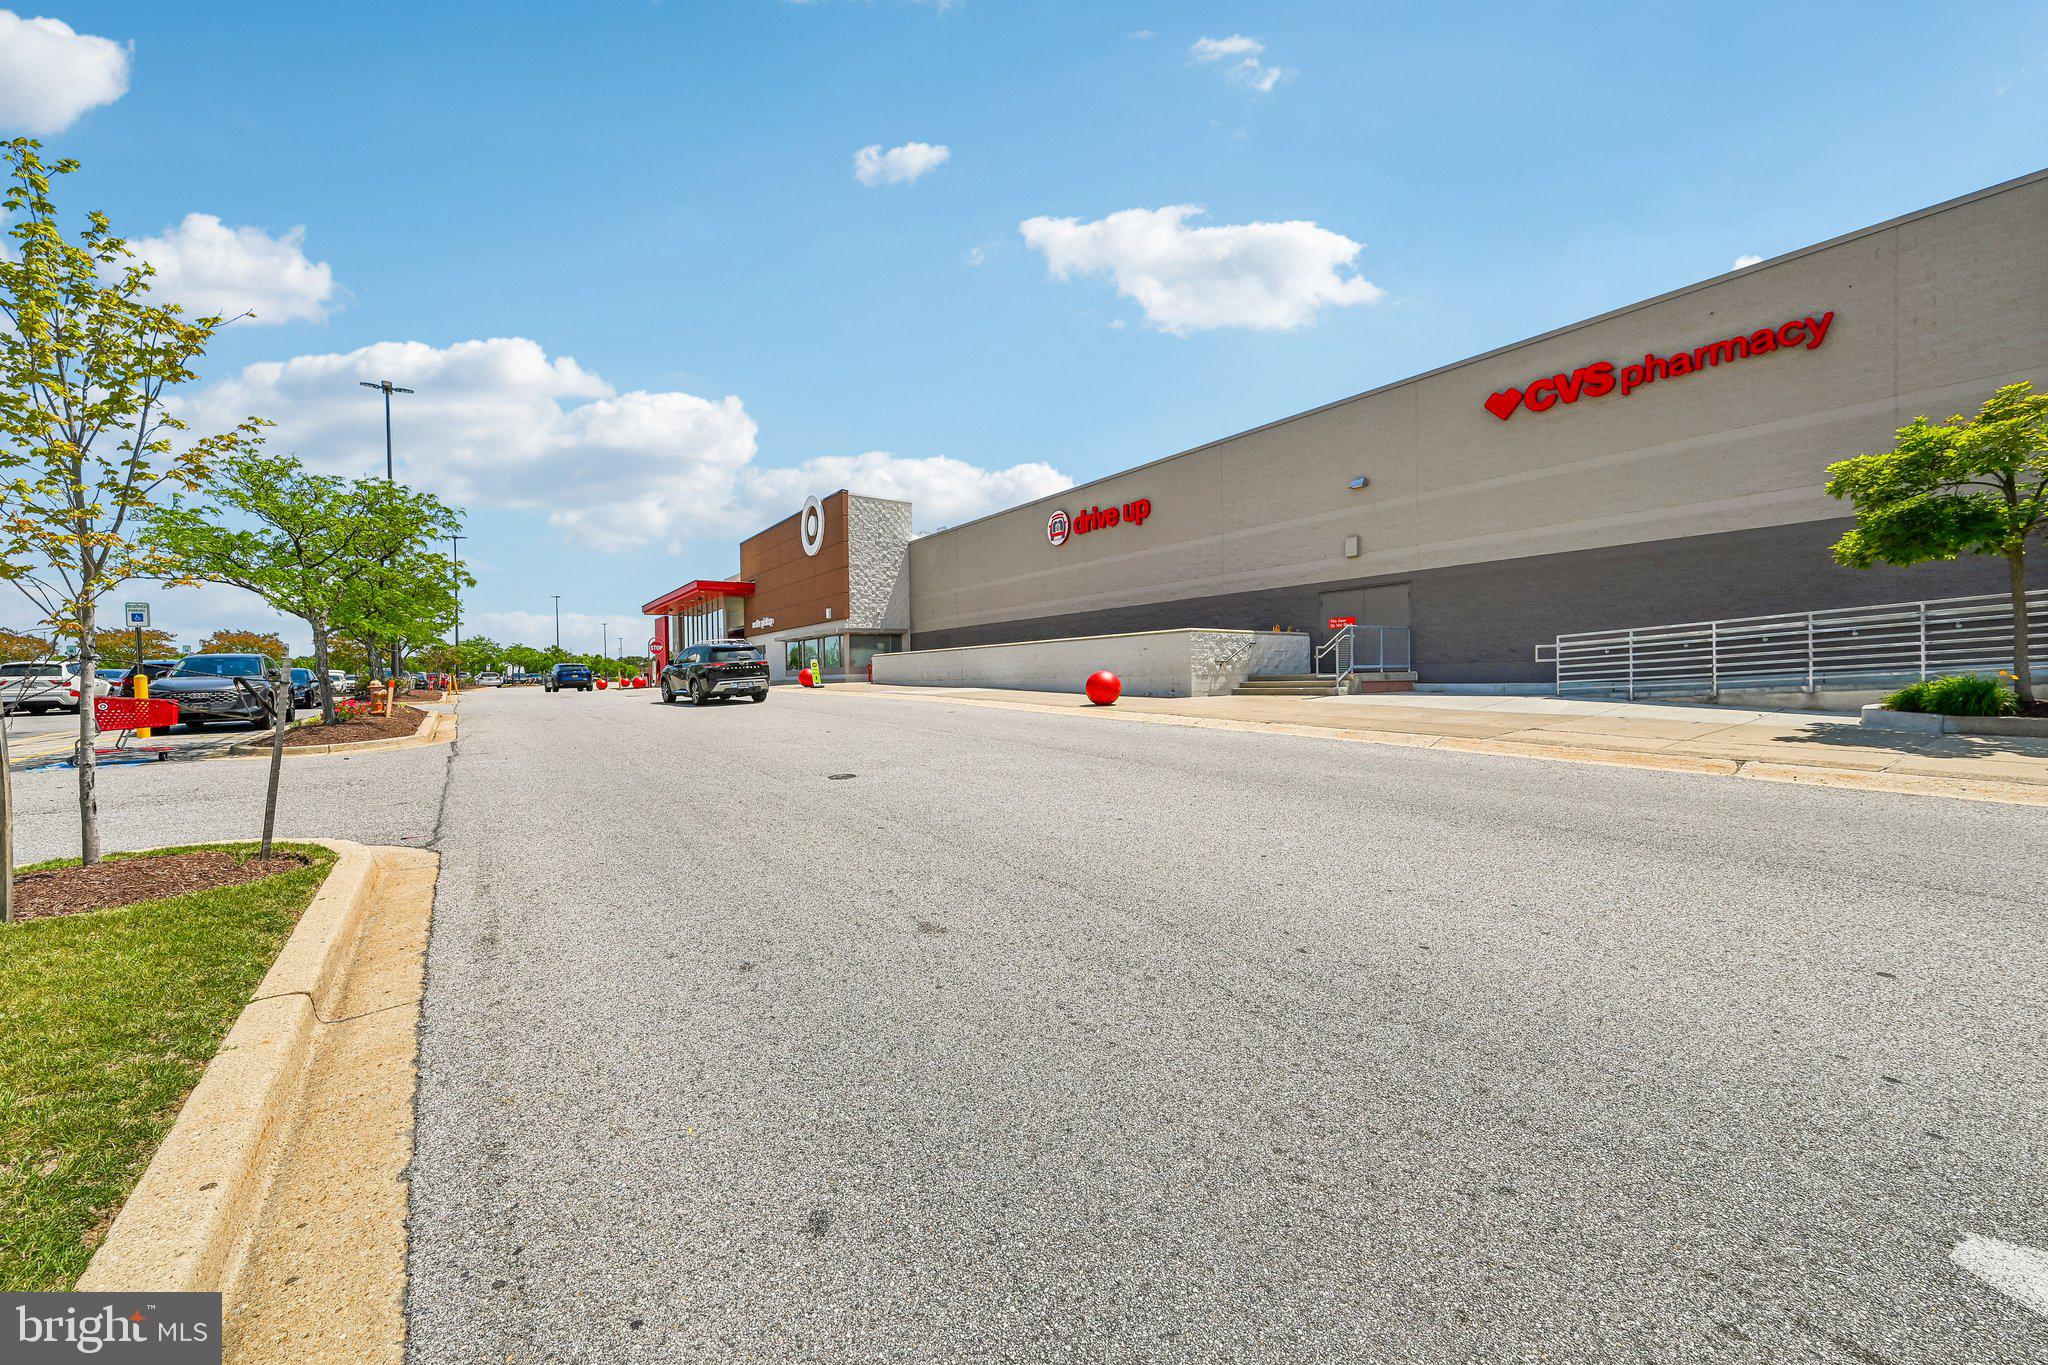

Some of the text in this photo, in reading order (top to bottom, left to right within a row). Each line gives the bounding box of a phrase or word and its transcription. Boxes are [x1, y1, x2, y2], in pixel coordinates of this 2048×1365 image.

[1523, 311, 1835, 413] CVS pharmacy
[1073, 498, 1151, 534] drive up
